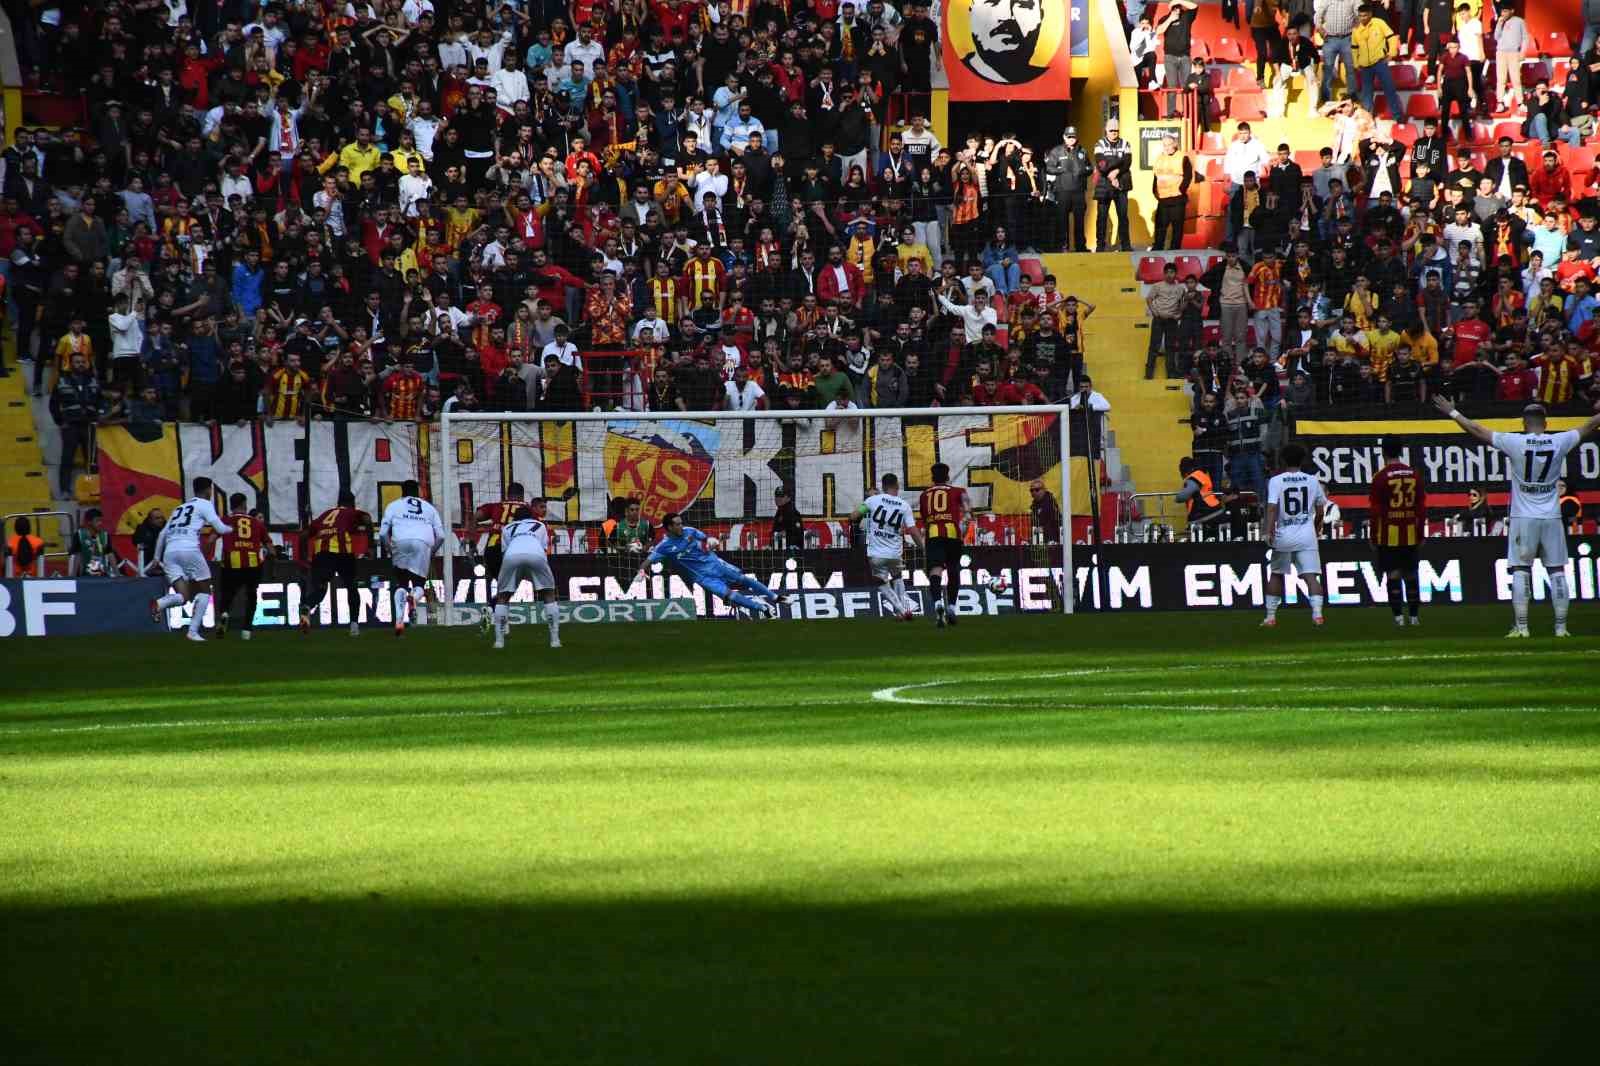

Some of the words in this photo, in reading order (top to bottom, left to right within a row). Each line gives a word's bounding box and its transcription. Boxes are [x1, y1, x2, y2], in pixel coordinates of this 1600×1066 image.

[715, 416, 994, 520] KALE
[1524, 449, 1555, 483] 17
[407, 497, 423, 515] 9
[926, 489, 948, 514] 10
[1283, 486, 1309, 516] 61
[1387, 477, 1417, 509] 33
[168, 505, 194, 529] 23
[237, 517, 252, 539] 8
[322, 509, 340, 527] 4
[872, 504, 904, 533] 44
